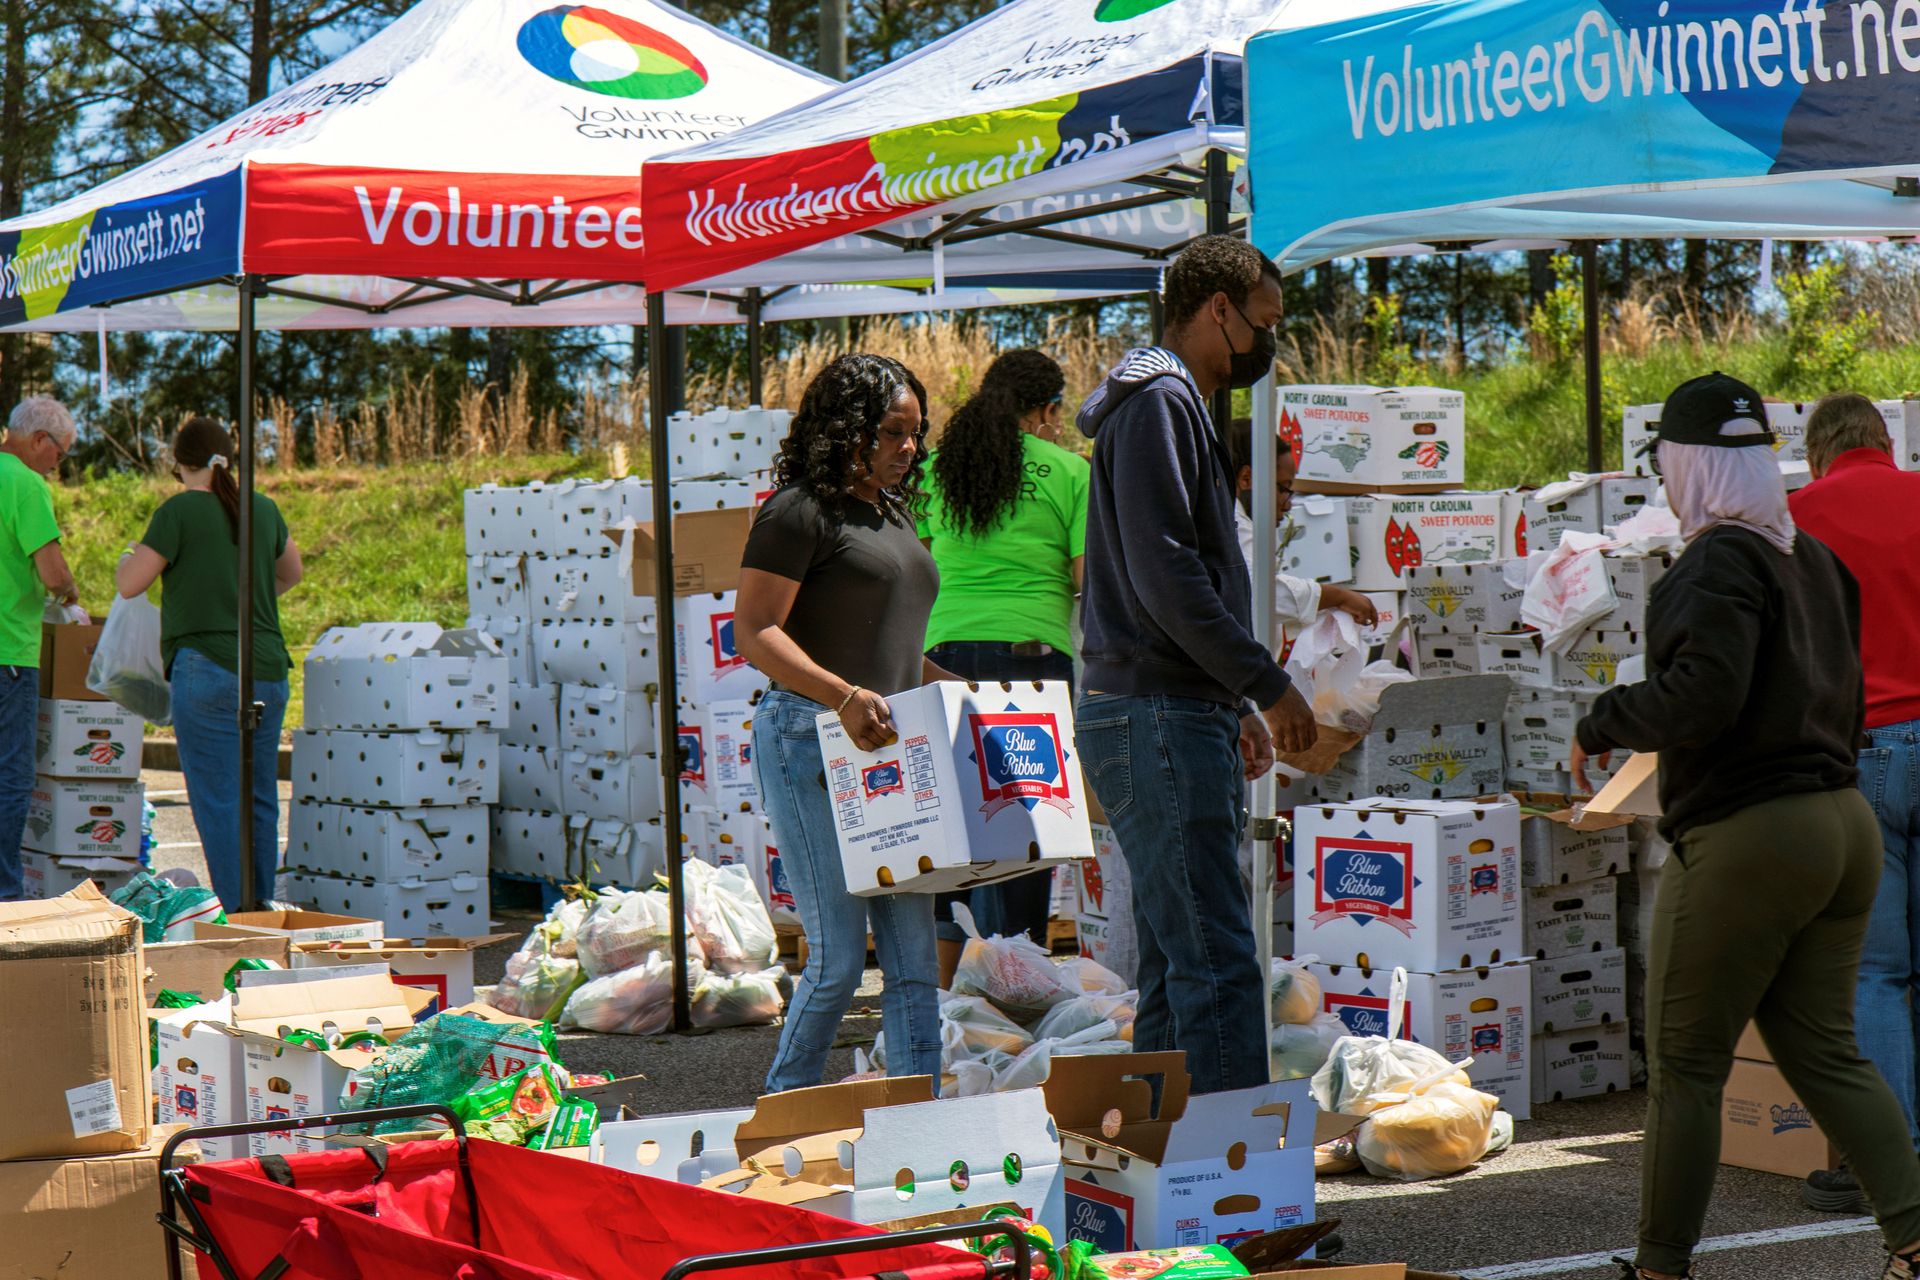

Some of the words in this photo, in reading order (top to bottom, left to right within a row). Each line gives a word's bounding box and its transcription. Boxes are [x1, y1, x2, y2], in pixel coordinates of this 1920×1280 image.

[560, 106, 747, 128] Volunteer
[1284, 392, 1308, 404] NORTH
[1312, 393, 1348, 407] CAROLINA
[1304, 408, 1326, 420] SWEET
[1328, 409, 1370, 423] POTATOES
[1400, 411, 1420, 420] NORTH
[1421, 411, 1447, 420] CAROLINA
[1402, 470, 1421, 481] SWEET
[1422, 470, 1447, 480] POTATOES
[1392, 501, 1424, 514] NORTH
[1430, 500, 1473, 513] CAROLINA
[1420, 516, 1450, 527] SWEET
[1452, 515, 1496, 526] POTATOES
[1410, 585, 1446, 598] SOUTHERN
[1447, 586, 1475, 596] VALLEY
[1004, 728, 1037, 752] Blue
[1000, 752, 1045, 776] Ribbon
[1387, 750, 1448, 767] SOUTHERN
[1450, 748, 1488, 761] VALLEY
[914, 789, 934, 801] OTHER
[1011, 784, 1043, 794] VEGETABLES
[1345, 853, 1382, 875] Blue
[1336, 873, 1386, 897] Ribbon
[1351, 1009, 1383, 1033] Blue
[1168, 1173, 1195, 1185] PRODUCE
[1196, 1173, 1204, 1182] OF
[1205, 1172, 1223, 1182] U.S.A.
[1073, 1202, 1106, 1233] Blue
[1274, 1205, 1301, 1216] PEPPERS
[1176, 1218, 1200, 1229] CUKES
